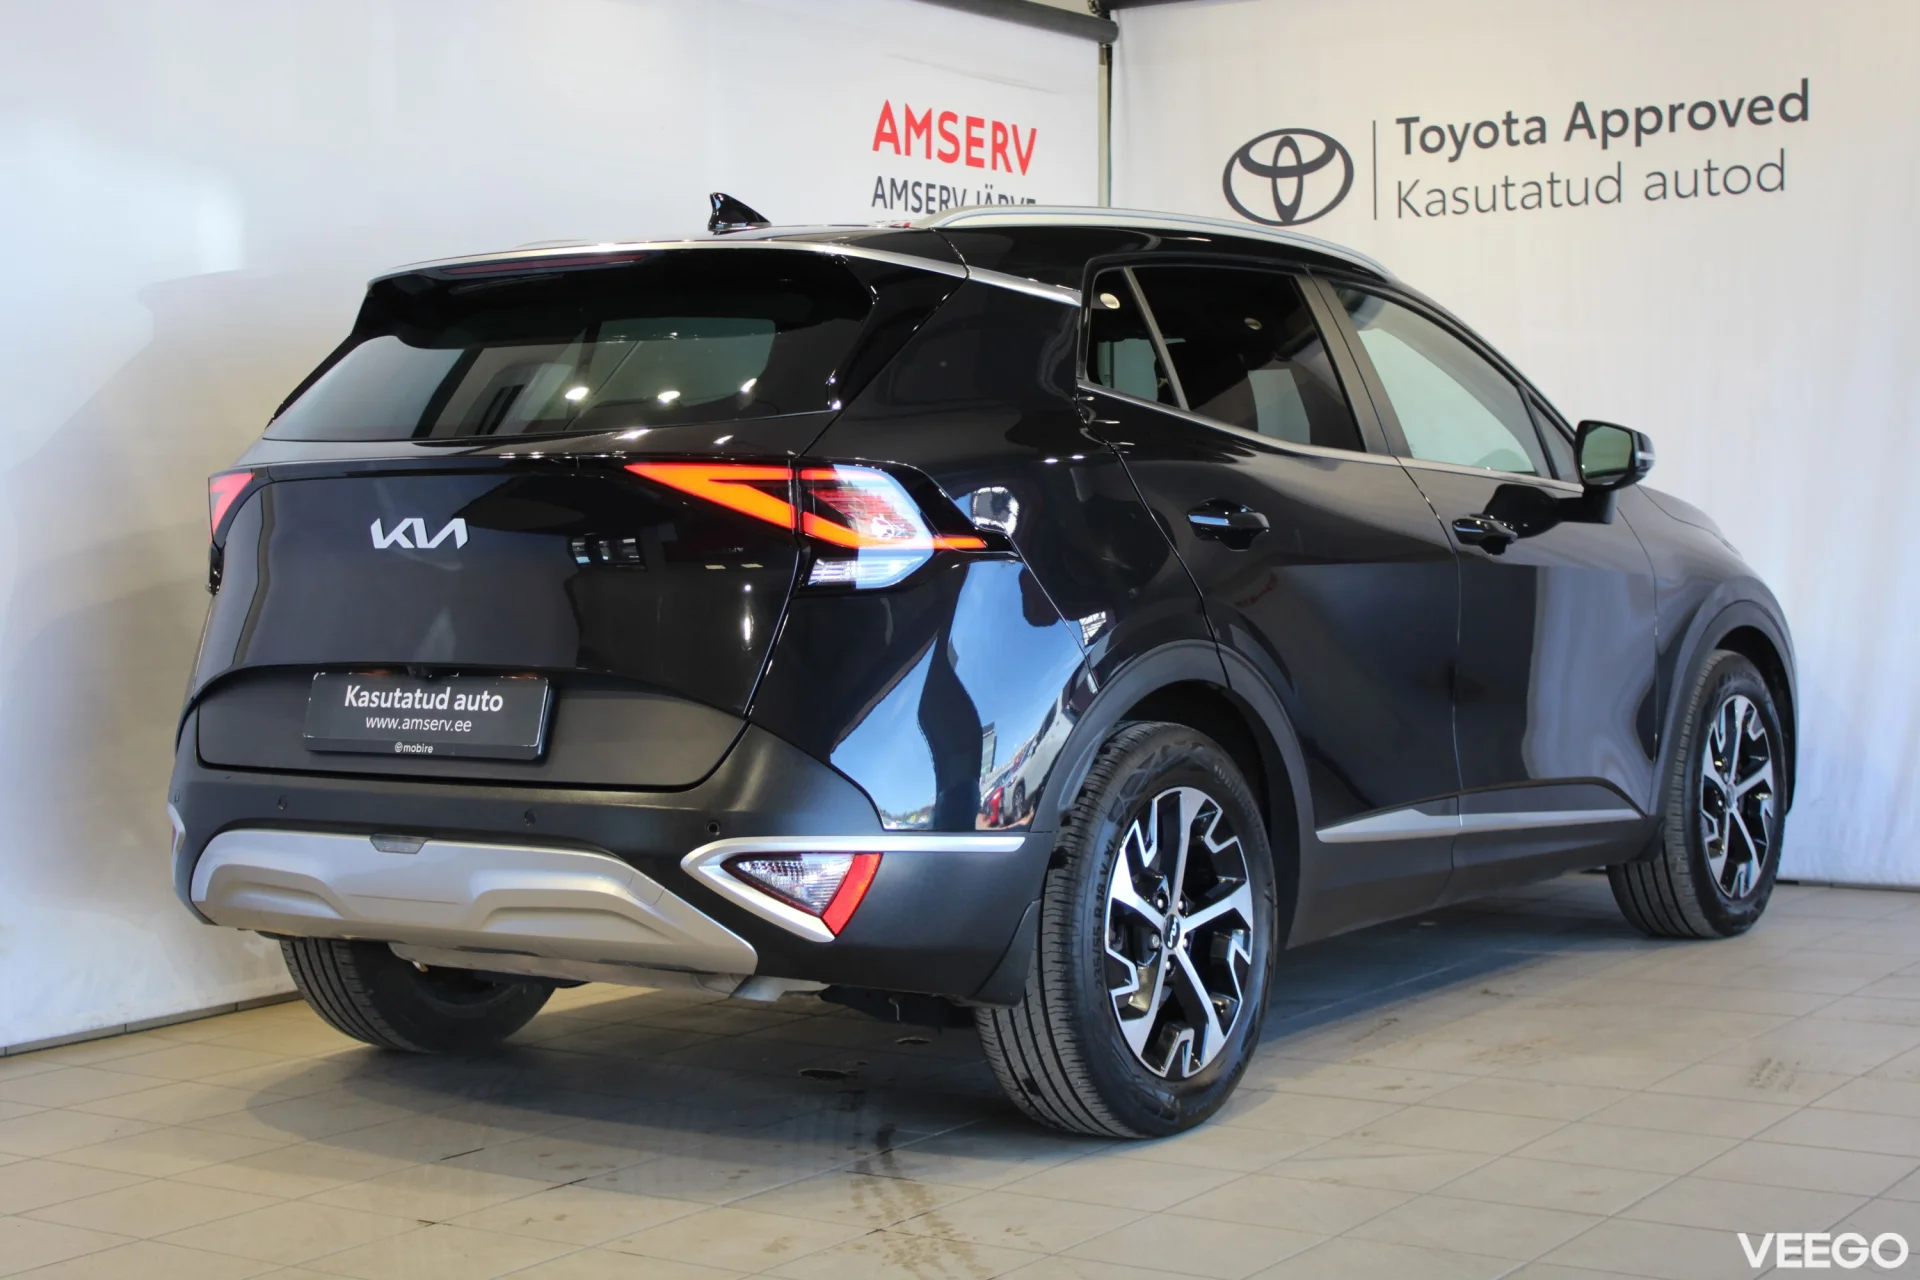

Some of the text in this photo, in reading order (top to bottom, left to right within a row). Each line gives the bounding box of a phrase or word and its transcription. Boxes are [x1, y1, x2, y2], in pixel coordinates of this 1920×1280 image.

[872, 99, 1037, 176] AMSERV
[1396, 78, 1810, 163] Toyota Approved
[871, 175, 967, 214] AMSERV
[1397, 148, 1786, 219] Kasutatud autod
[370, 518, 469, 550] KIA
[344, 685, 504, 712] Kasutatud auto
[365, 716, 472, 732] www.amserv.ee
[403, 743, 434, 754] mobire
